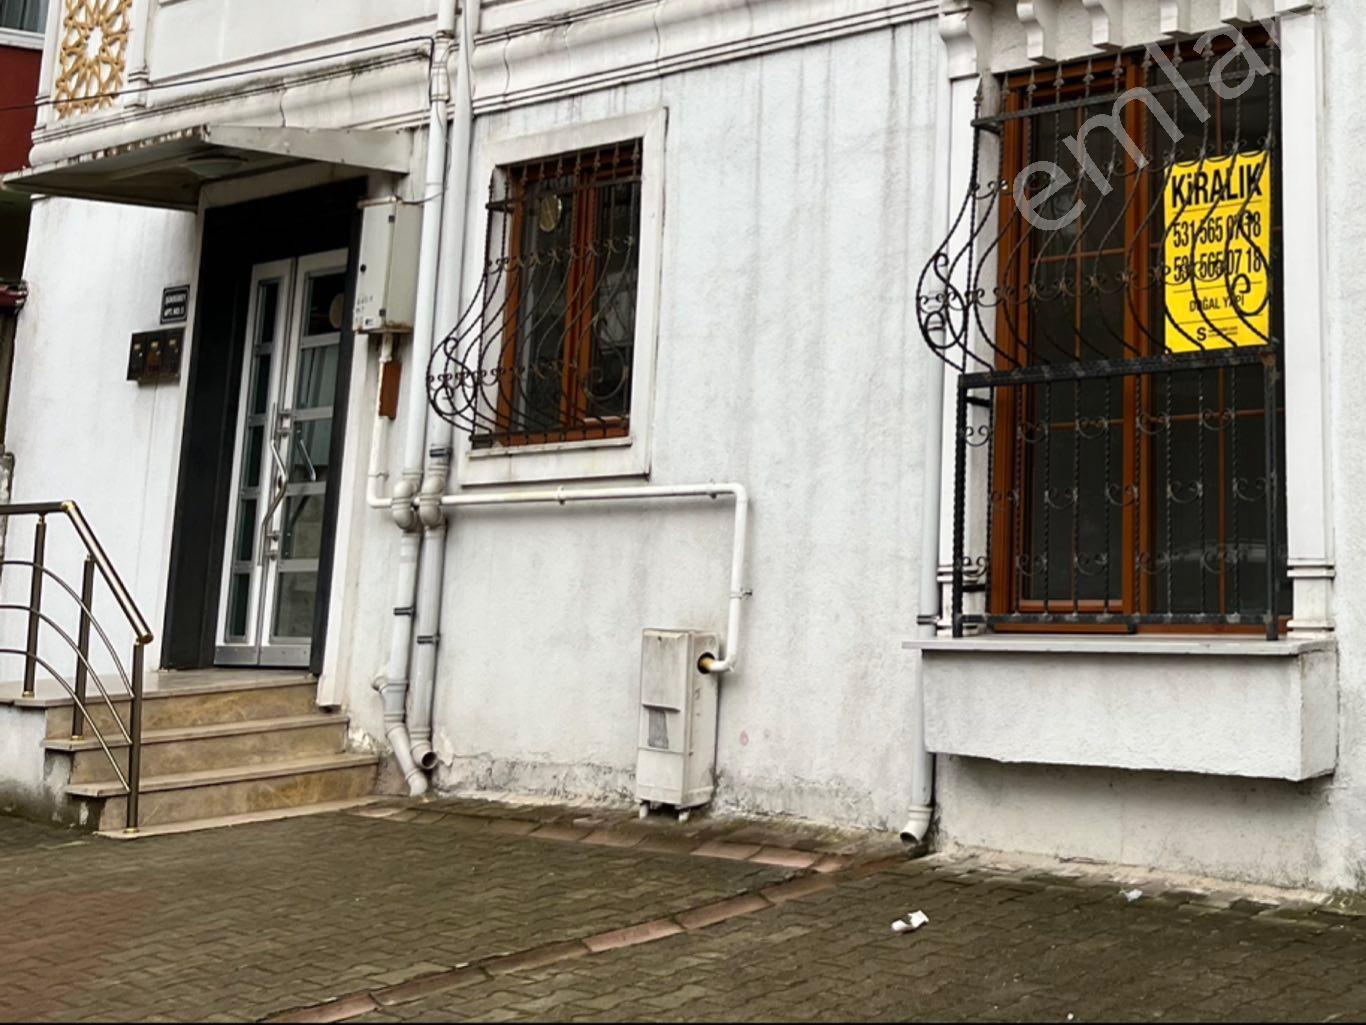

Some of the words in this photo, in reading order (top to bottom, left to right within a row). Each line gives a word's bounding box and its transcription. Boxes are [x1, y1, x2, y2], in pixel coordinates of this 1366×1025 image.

[1174, 254, 1195, 282] 53
[1226, 249, 1242, 275] 07
[1246, 247, 1261, 273] 18
